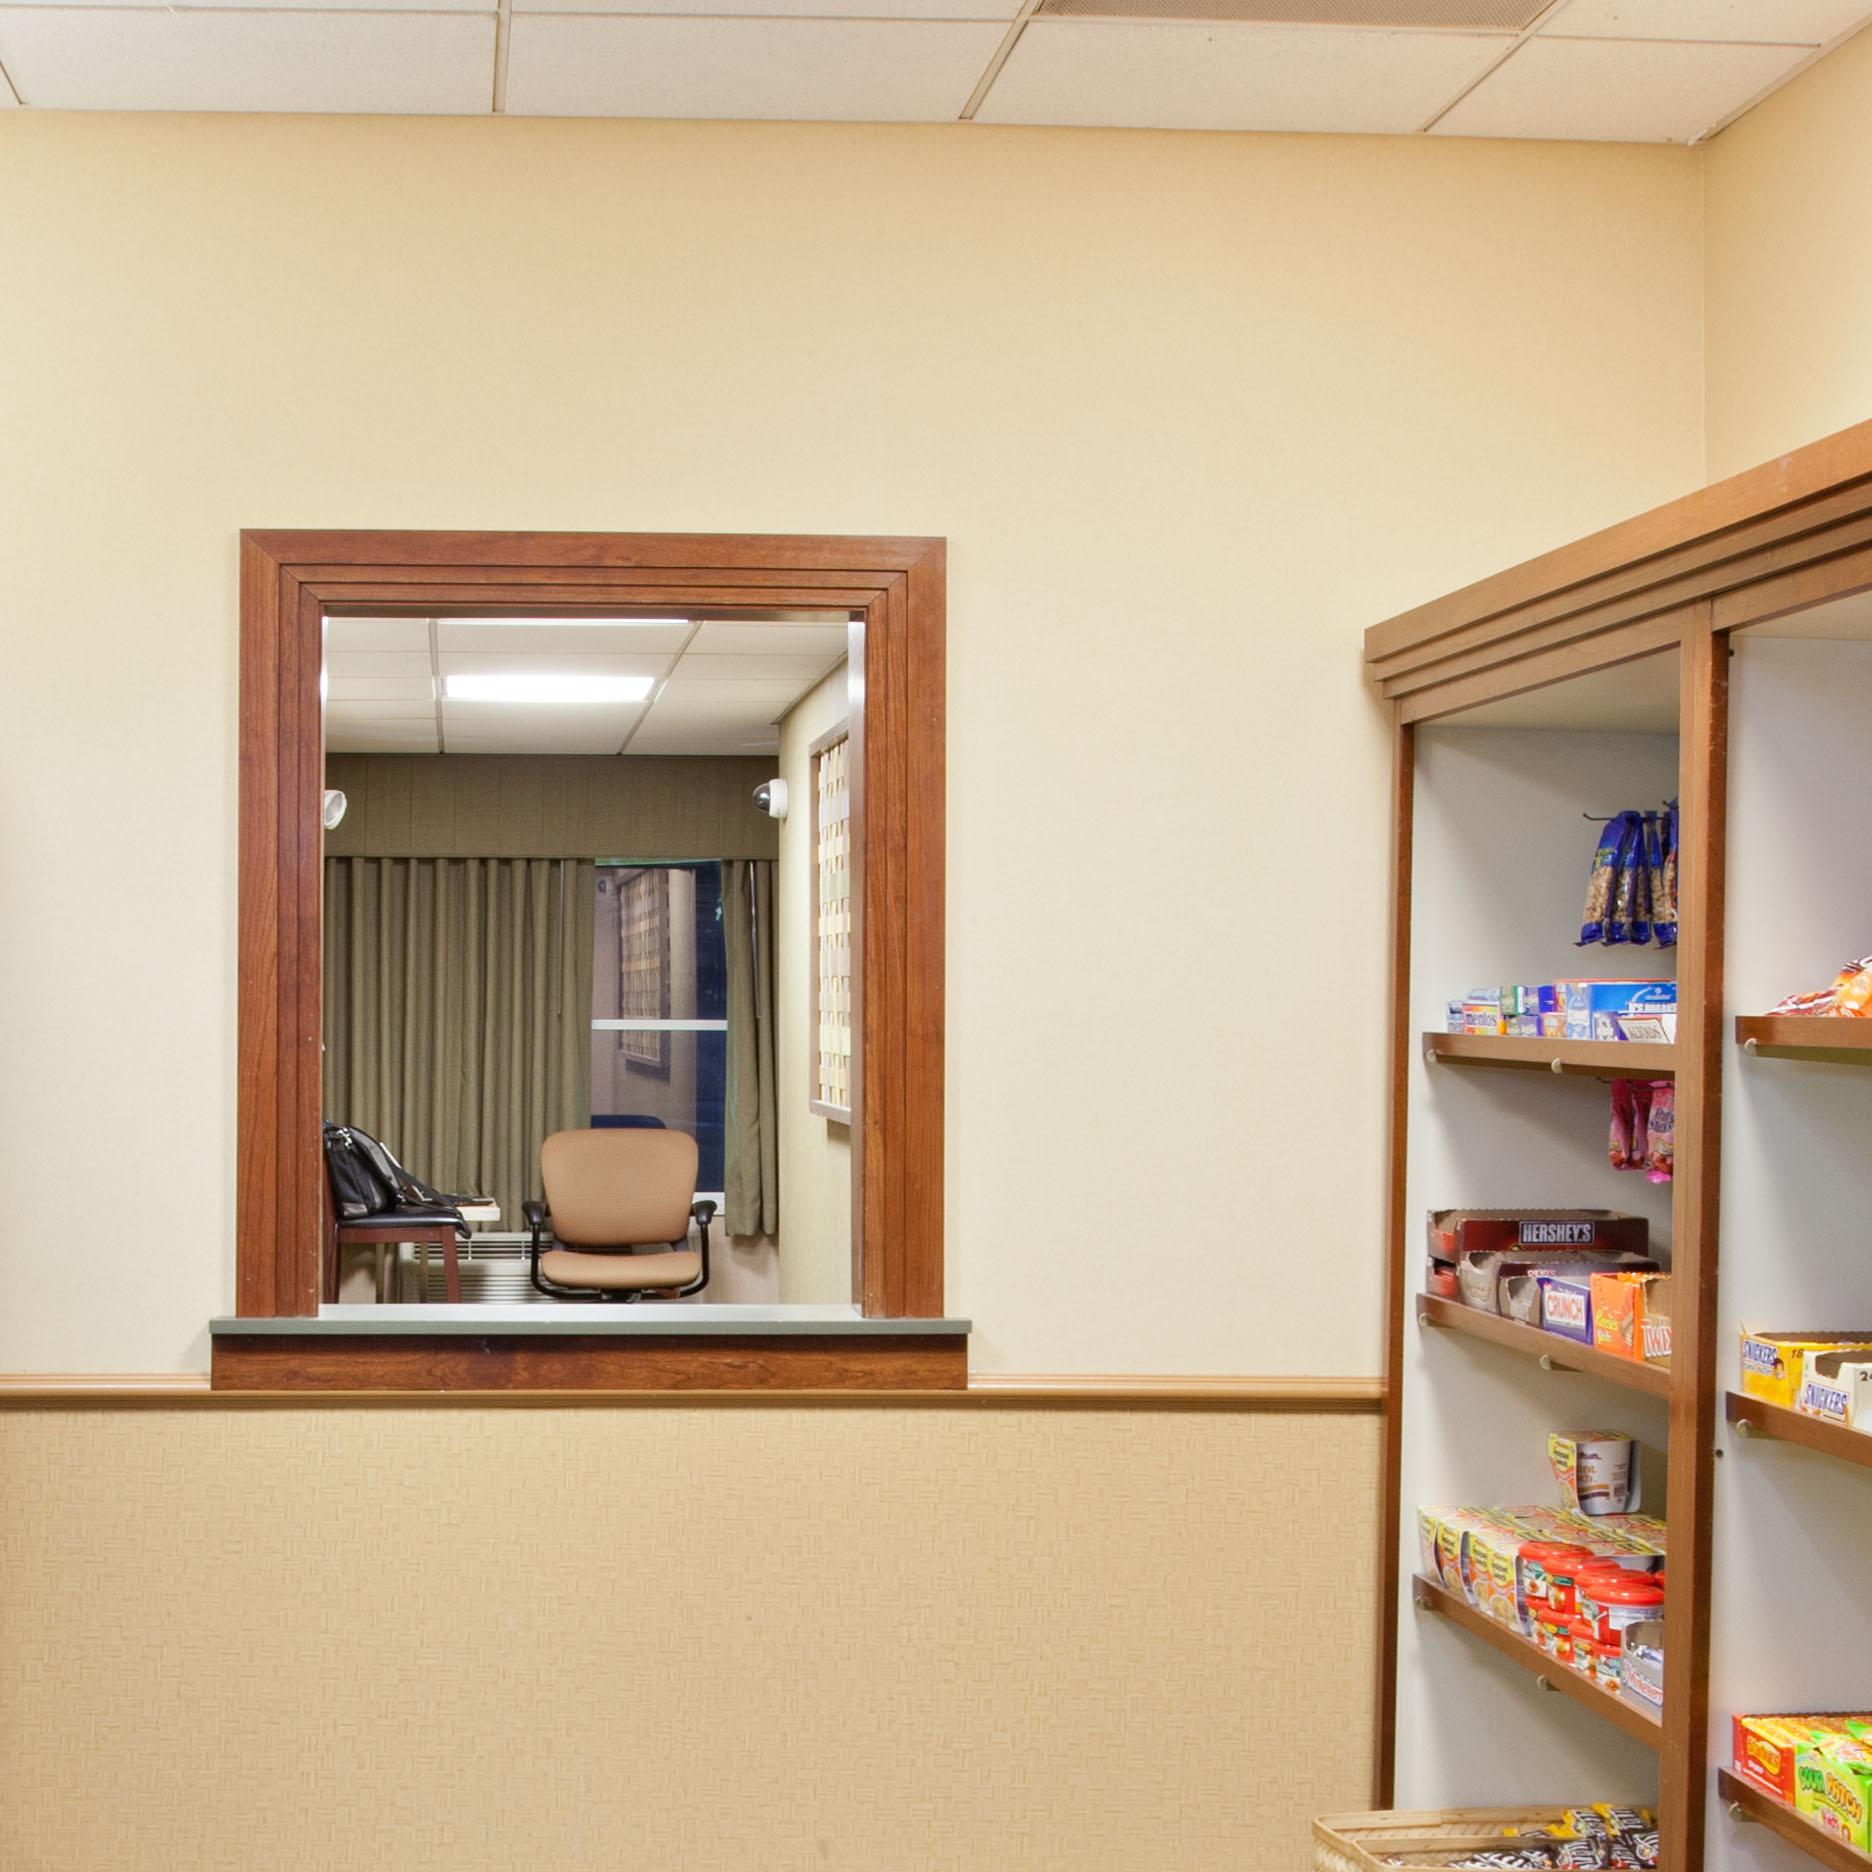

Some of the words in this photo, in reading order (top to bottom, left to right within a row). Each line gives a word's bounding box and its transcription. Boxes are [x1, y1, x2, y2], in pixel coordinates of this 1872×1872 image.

[1465, 1010, 1498, 1027] mentos
[1521, 1223, 1593, 1244] HERSHEY'S
[1547, 1293, 1584, 1321] CRUNCH
[1743, 1340, 1777, 1366] SNICKERS
[1805, 1383, 1849, 1415] SNICKERS
